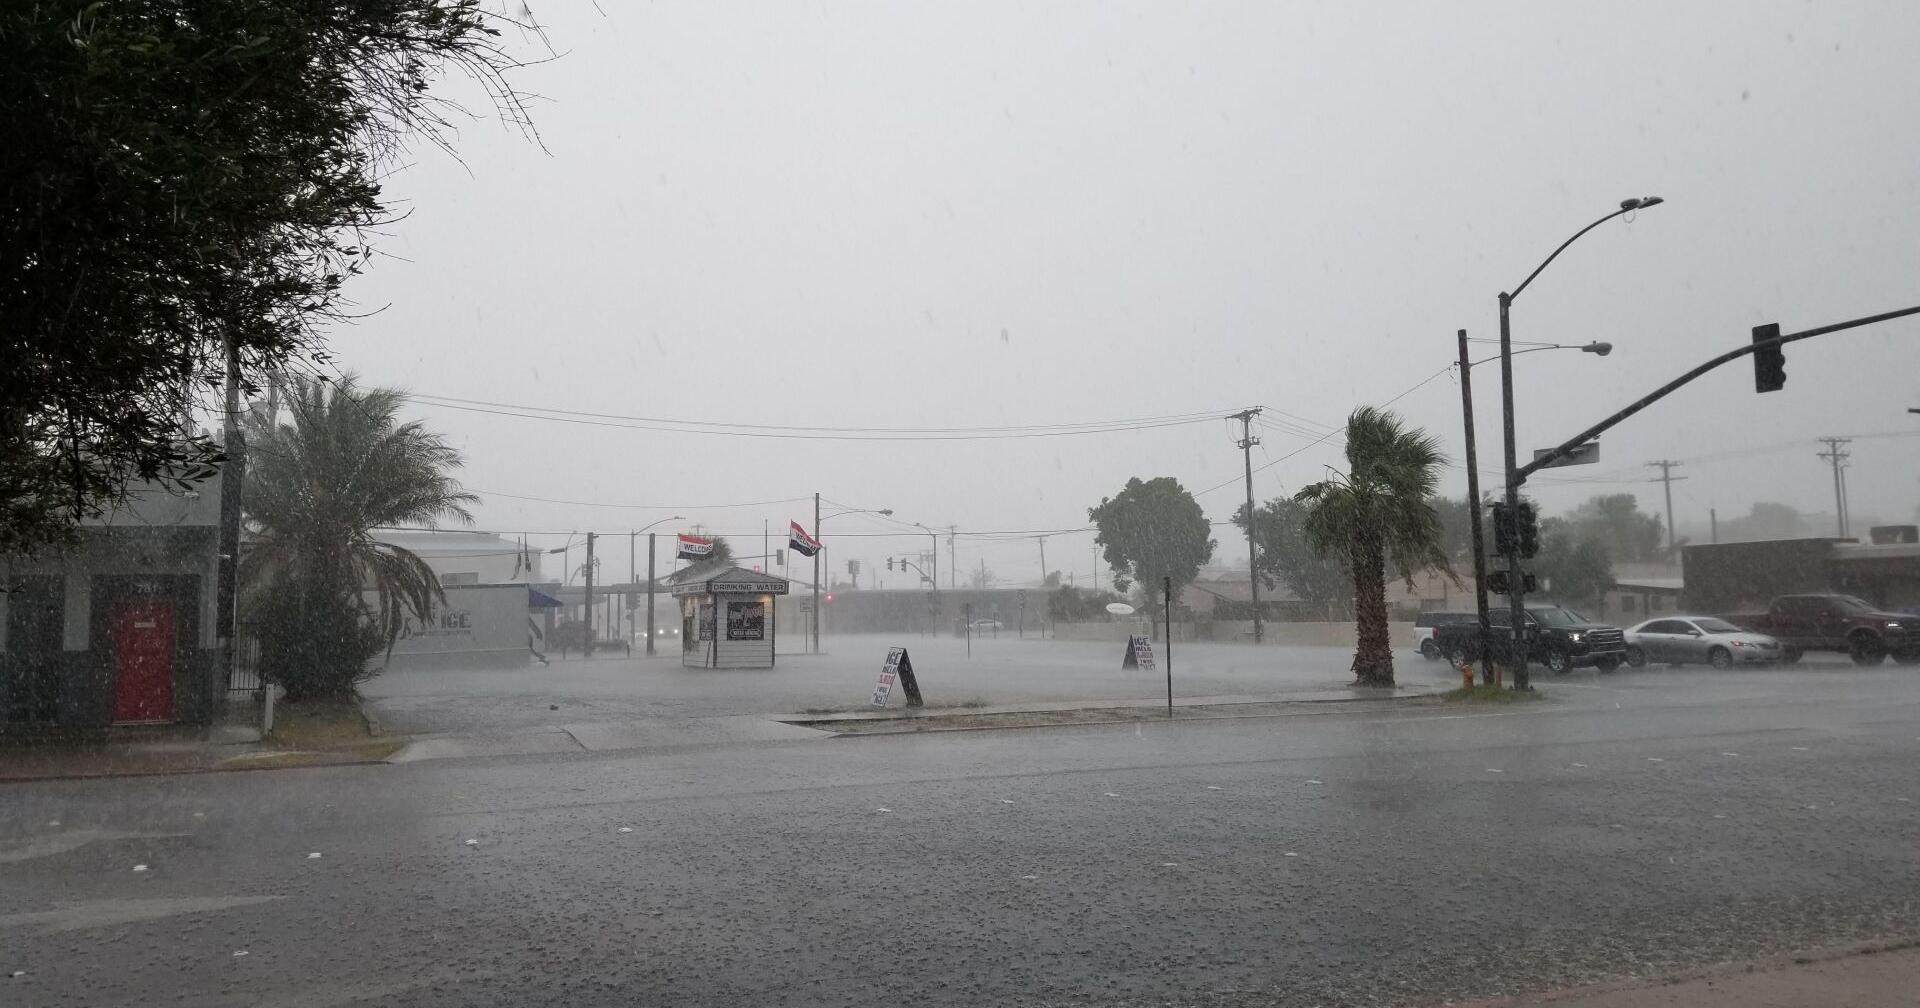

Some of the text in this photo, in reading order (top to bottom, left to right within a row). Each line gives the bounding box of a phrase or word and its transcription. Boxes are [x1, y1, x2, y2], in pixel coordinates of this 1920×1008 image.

[713, 584, 753, 592] DRINKING
[756, 584, 784, 592] WATER
[441, 609, 472, 629] ICE
[1133, 637, 1150, 646] ICE
[886, 651, 902, 665] ICE
